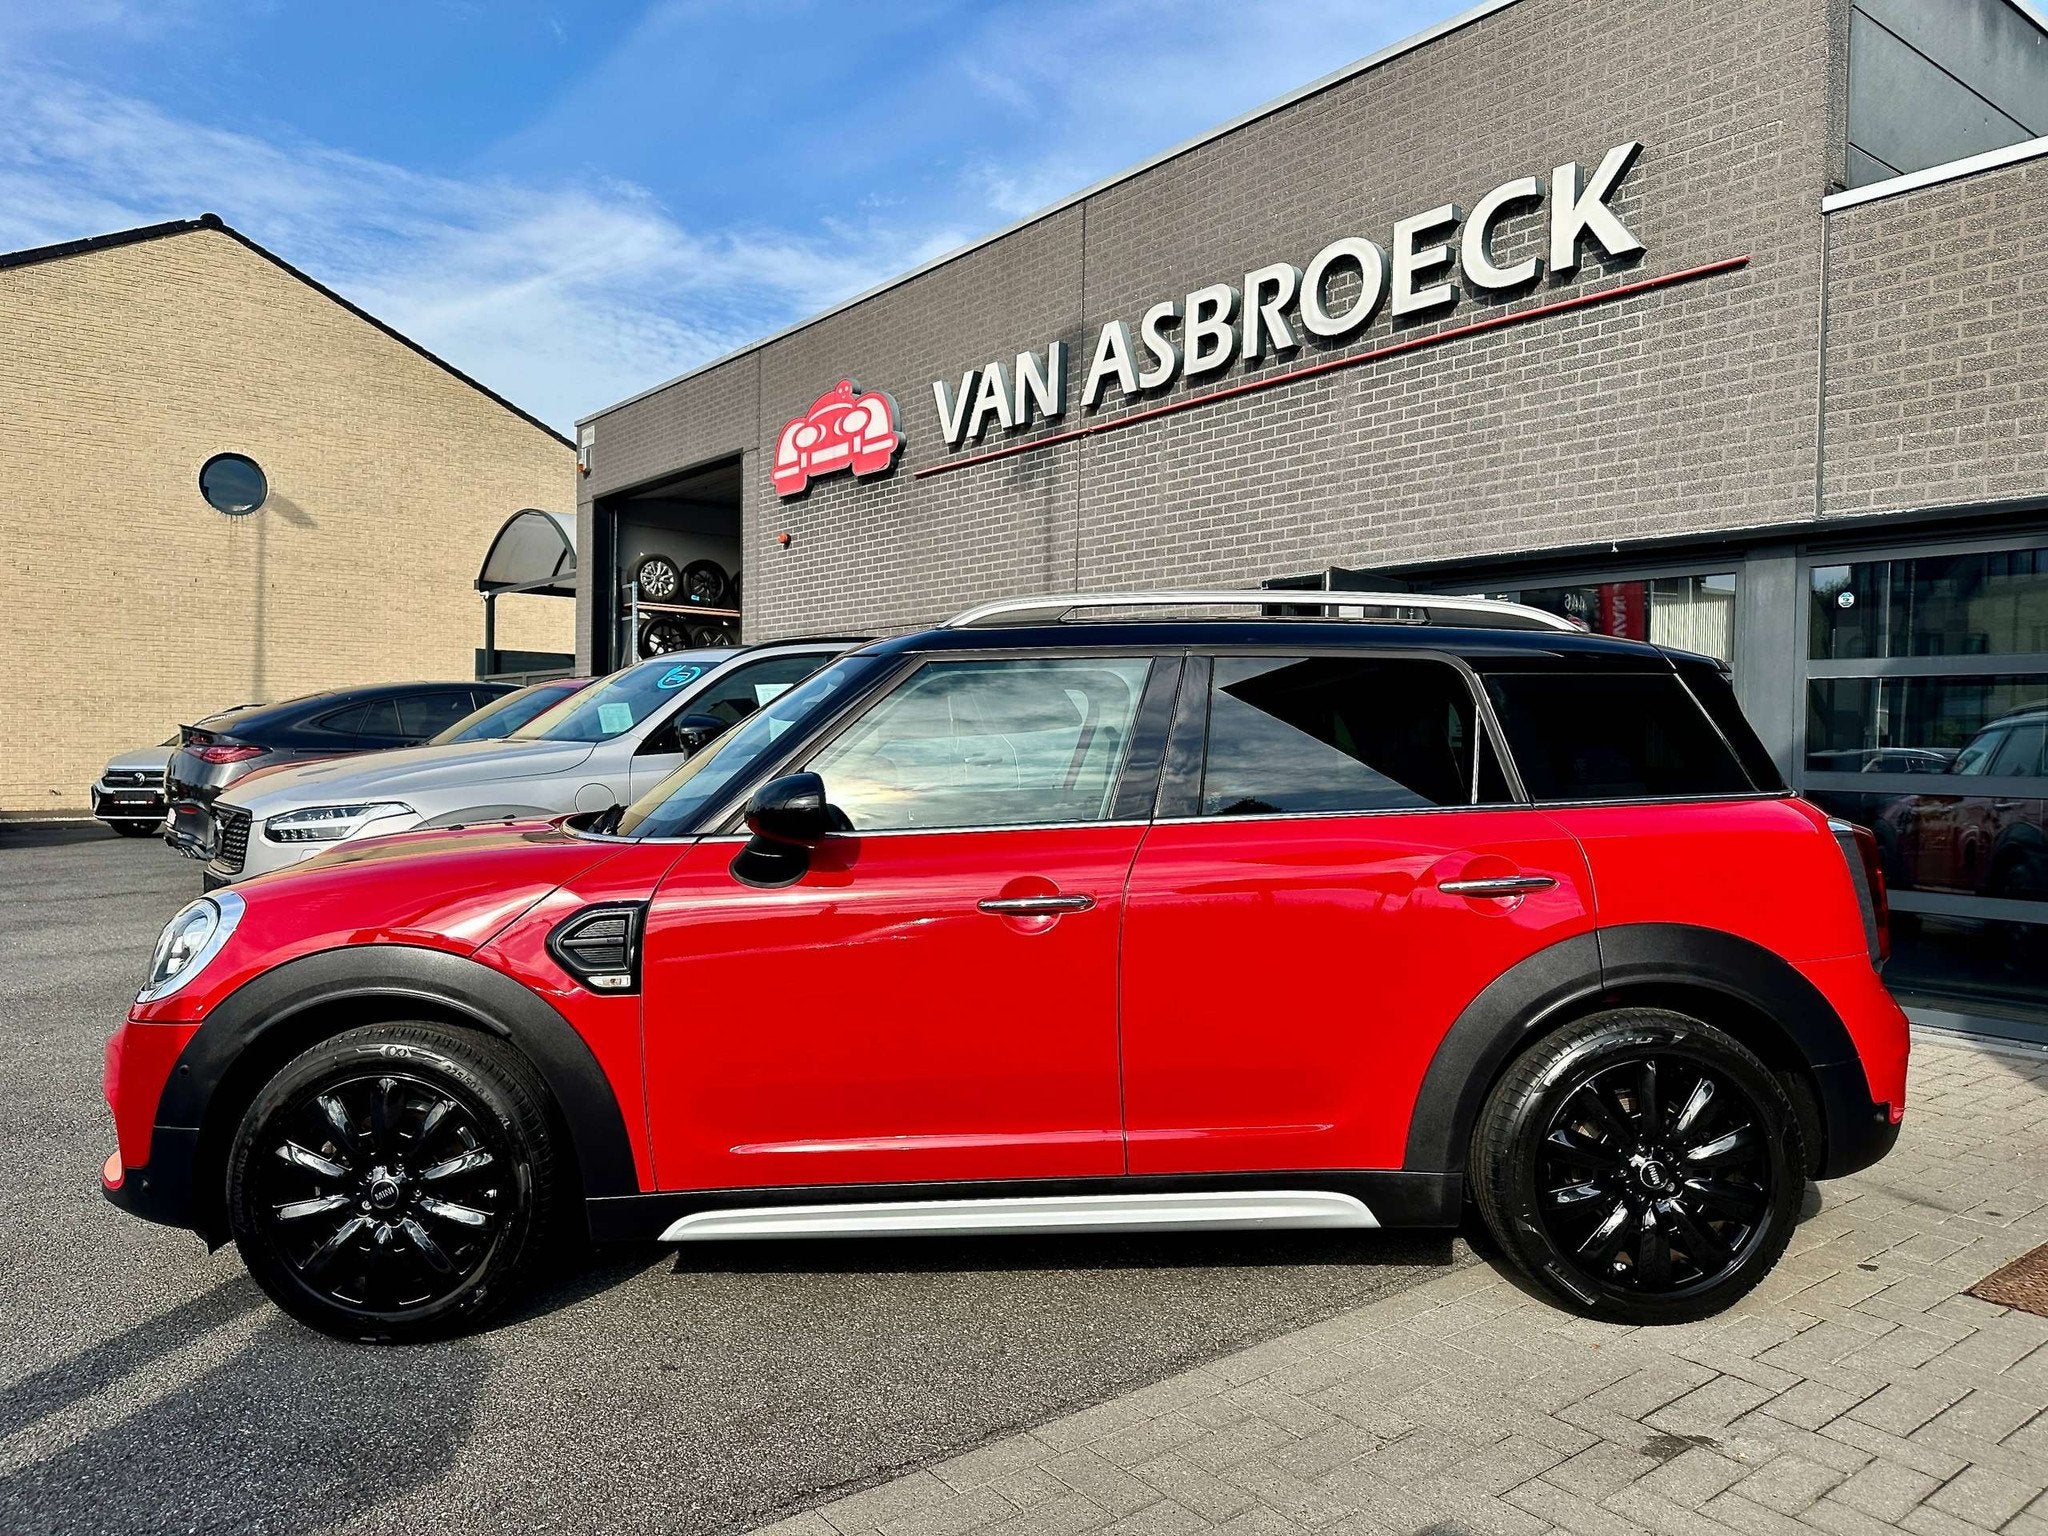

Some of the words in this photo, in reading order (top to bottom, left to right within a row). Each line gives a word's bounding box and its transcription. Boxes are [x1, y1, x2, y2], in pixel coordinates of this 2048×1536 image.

[932, 340, 1066, 444] VAN
[1080, 140, 1646, 407] ASBROECK
[444, 1065, 477, 1089] 225/50
[1648, 1164, 1661, 1185] MINI
[374, 1186, 395, 1201] MINI
